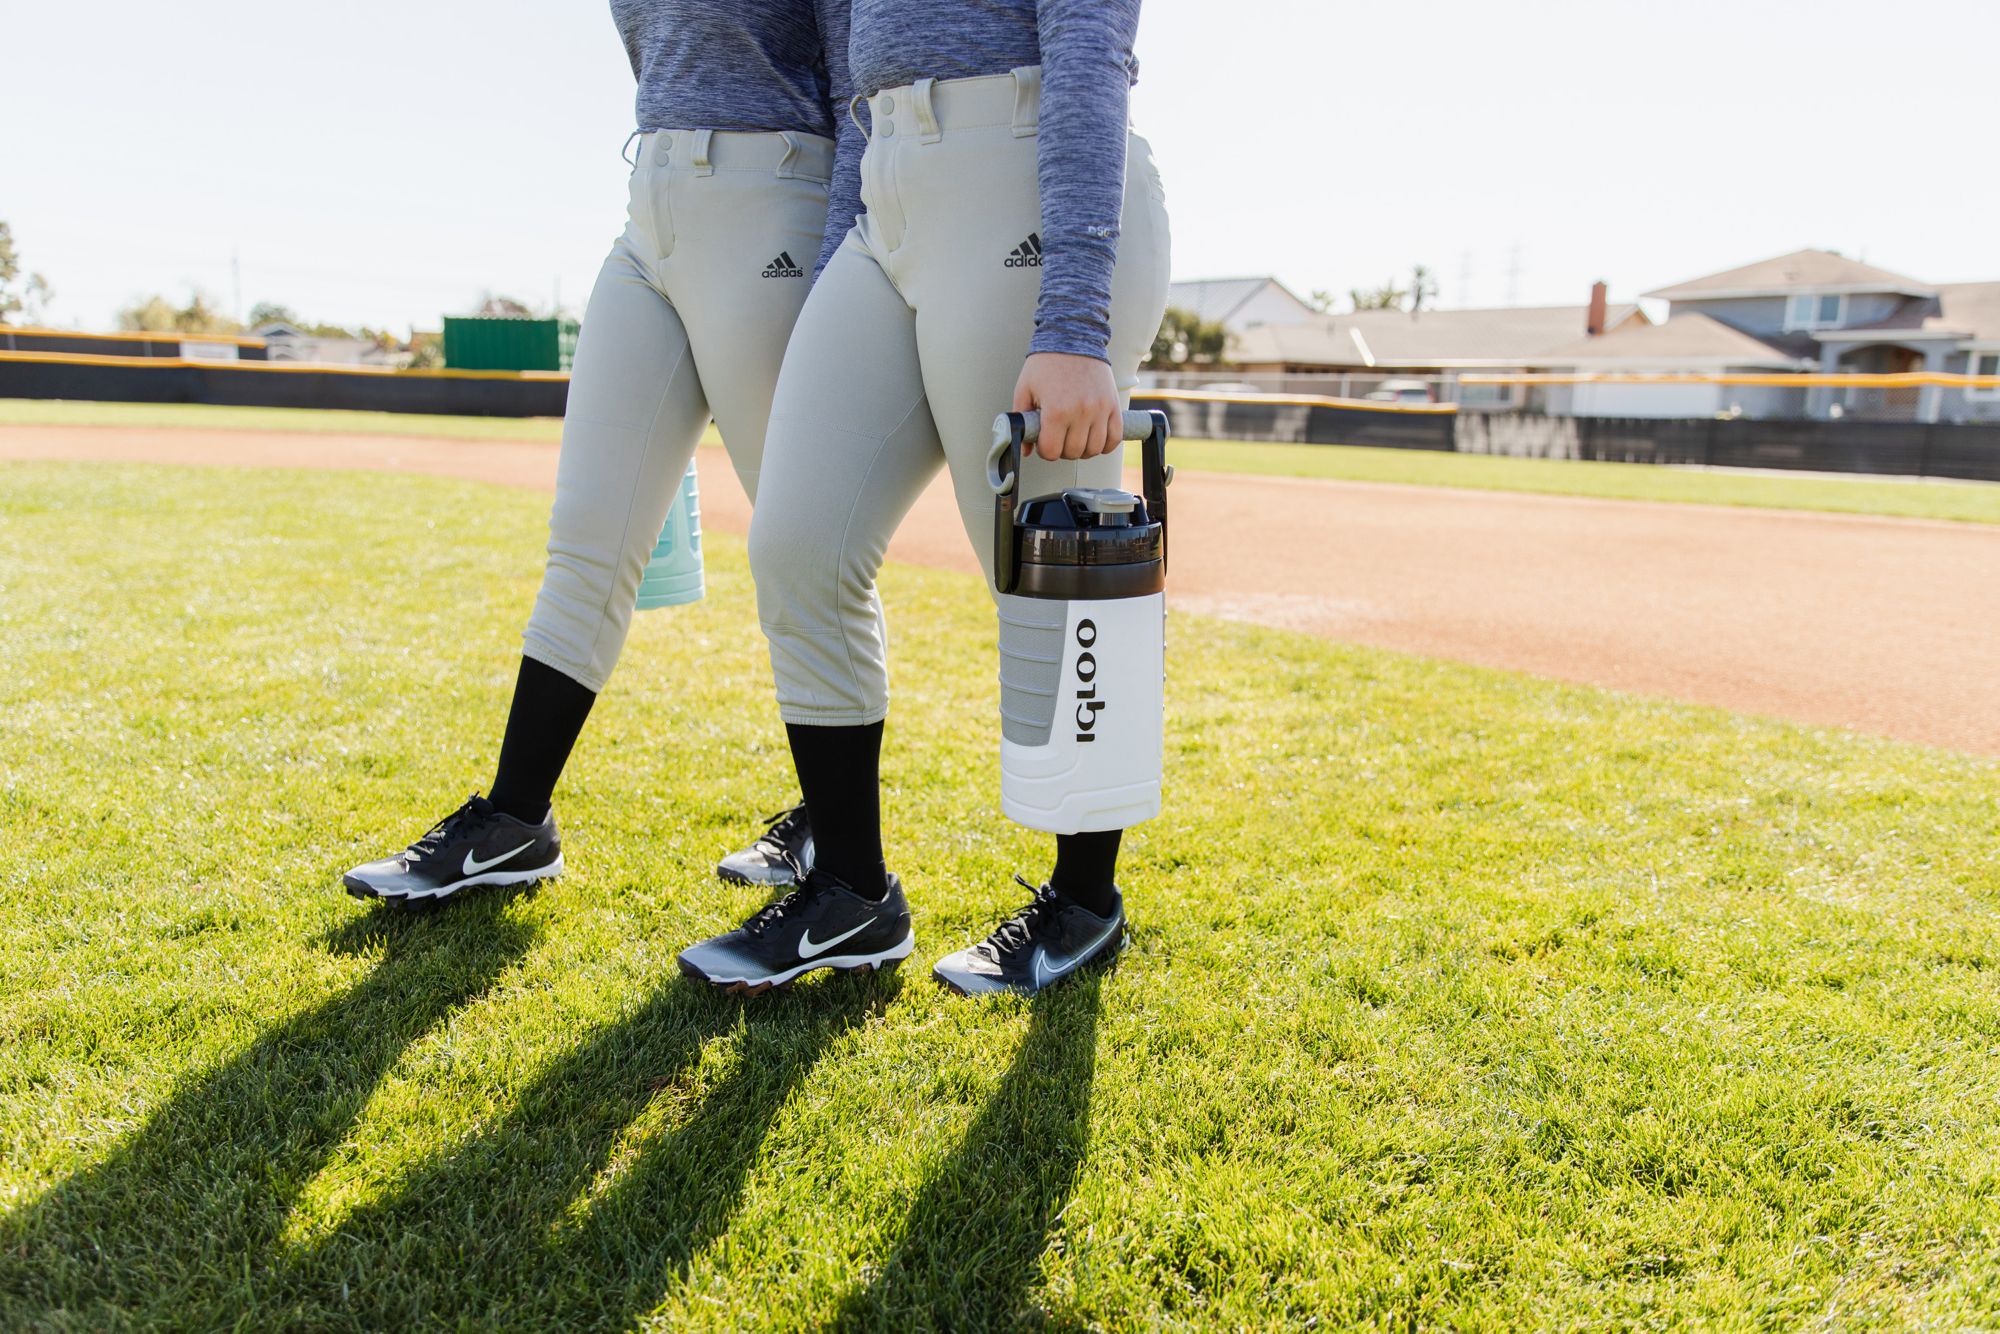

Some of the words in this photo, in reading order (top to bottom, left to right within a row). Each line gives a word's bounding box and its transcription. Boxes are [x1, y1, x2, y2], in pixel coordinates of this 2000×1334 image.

[1004, 254, 1043, 268] adid
[761, 267, 804, 279] adidas
[1076, 618, 1106, 742] IGLOO
